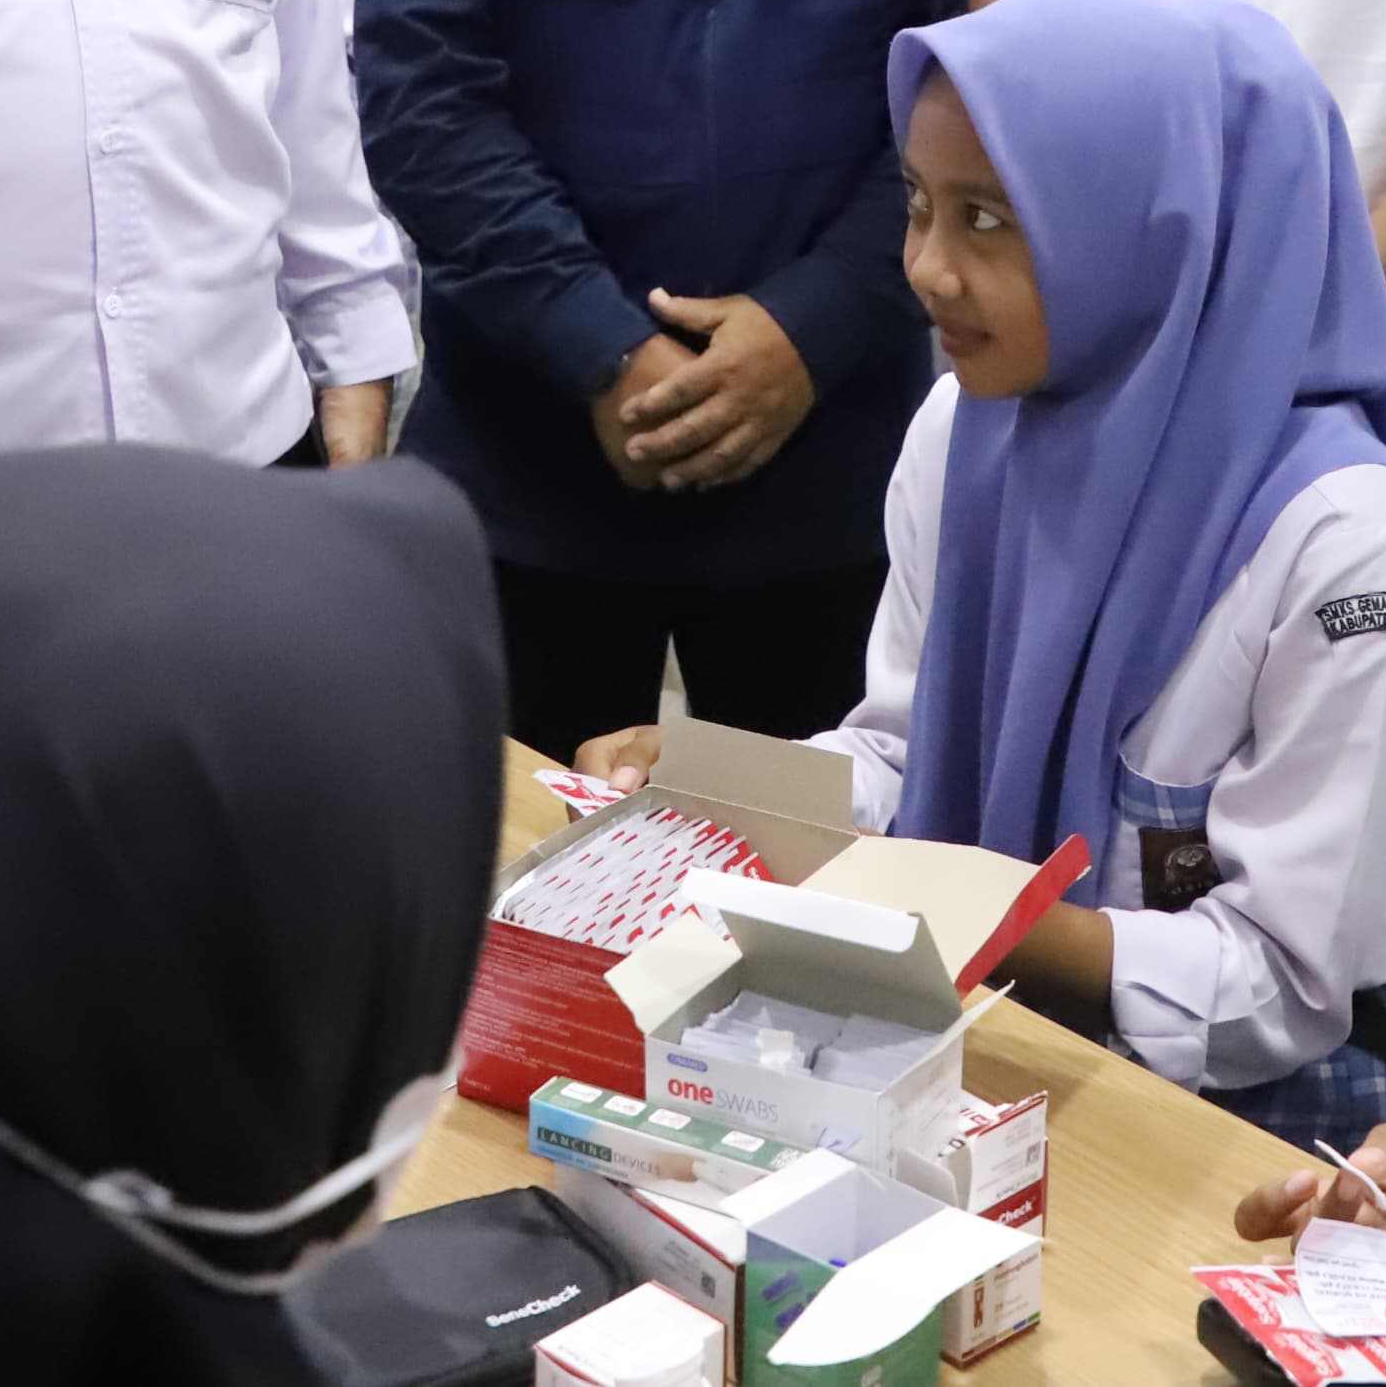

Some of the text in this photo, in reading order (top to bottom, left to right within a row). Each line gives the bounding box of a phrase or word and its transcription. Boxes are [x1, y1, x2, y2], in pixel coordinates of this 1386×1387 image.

[1322, 600, 1355, 623] SMKS
[540, 1128, 611, 1161] LANCING
[484, 1283, 582, 1328] BeneCheck
